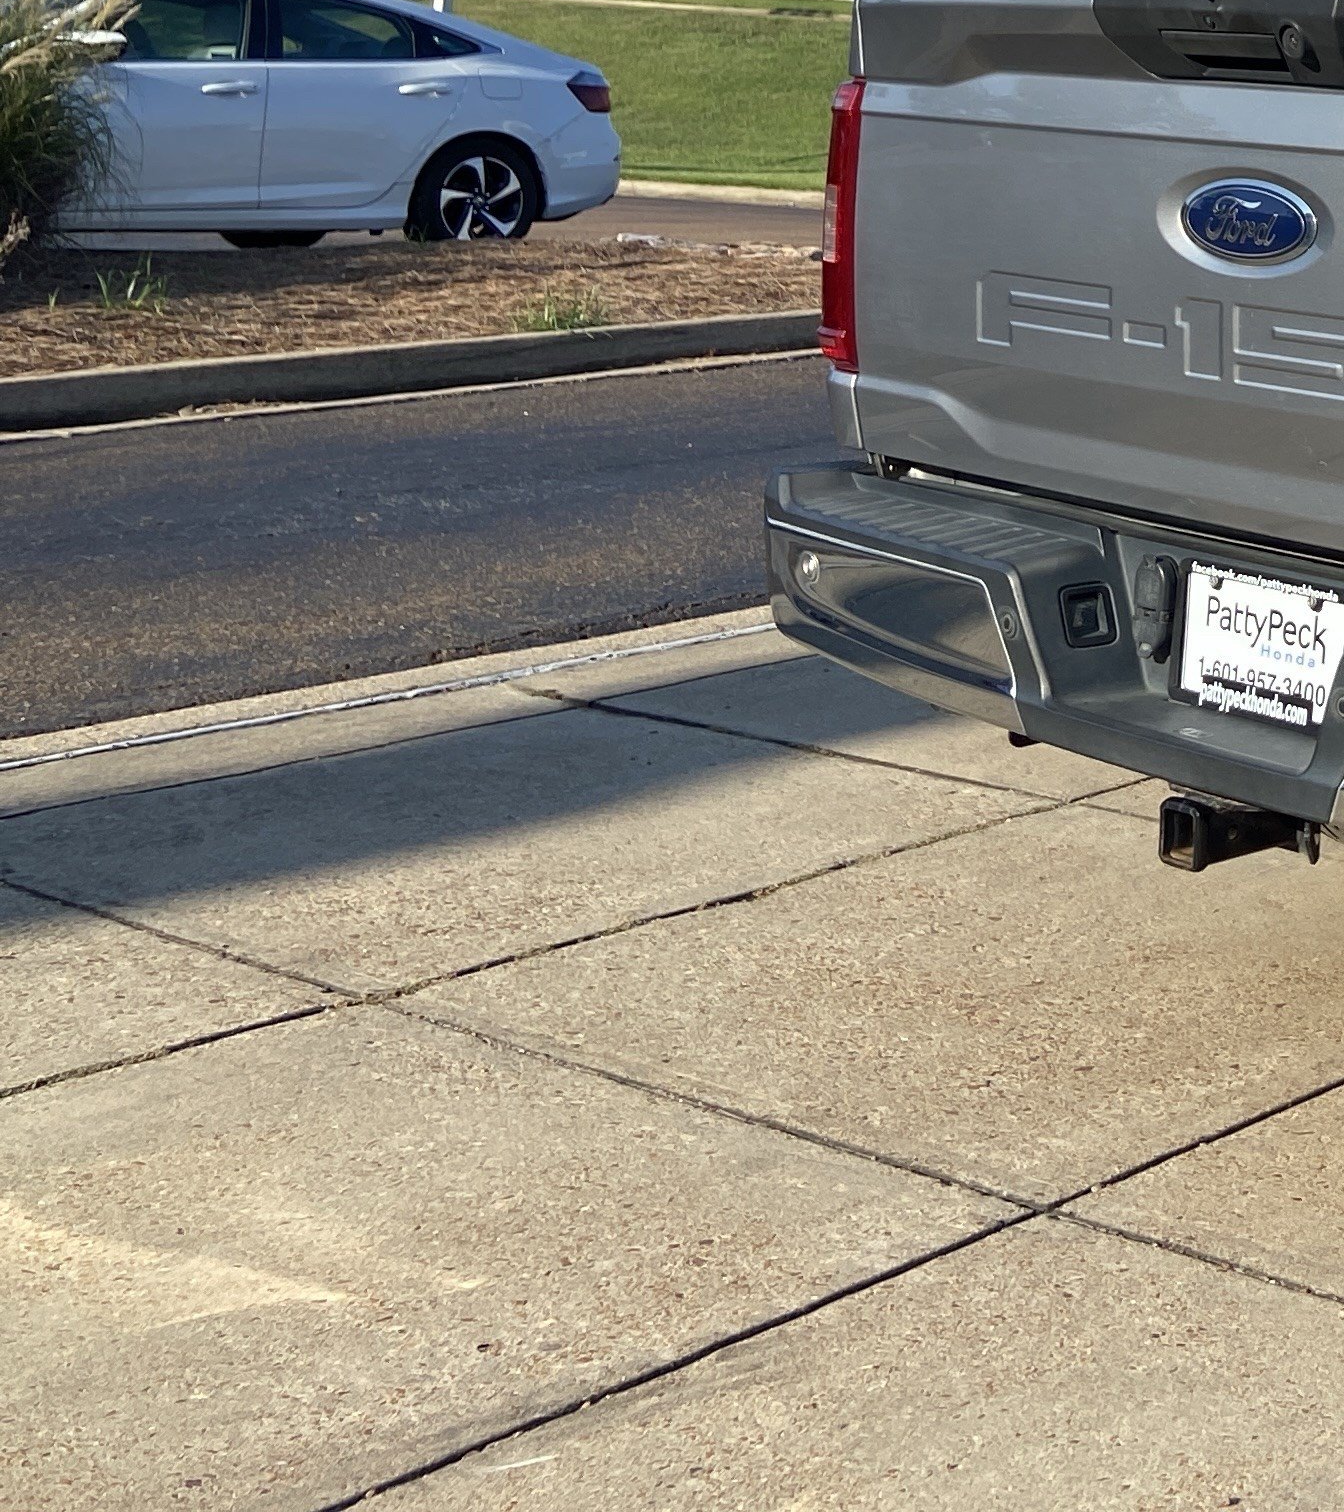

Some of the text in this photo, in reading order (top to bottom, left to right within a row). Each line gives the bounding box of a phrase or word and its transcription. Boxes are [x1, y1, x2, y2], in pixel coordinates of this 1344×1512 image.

[1205, 195, 1279, 247] Ford
[1192, 561, 1339, 602] facebook.com/pattypeckhonda
[1206, 595, 1327, 664] PattyPeck
[1260, 644, 1316, 668] Honda
[1198, 681, 1308, 726] pattypeckhonda.com
[1199, 656, 1326, 707] 1-601-957-3400
